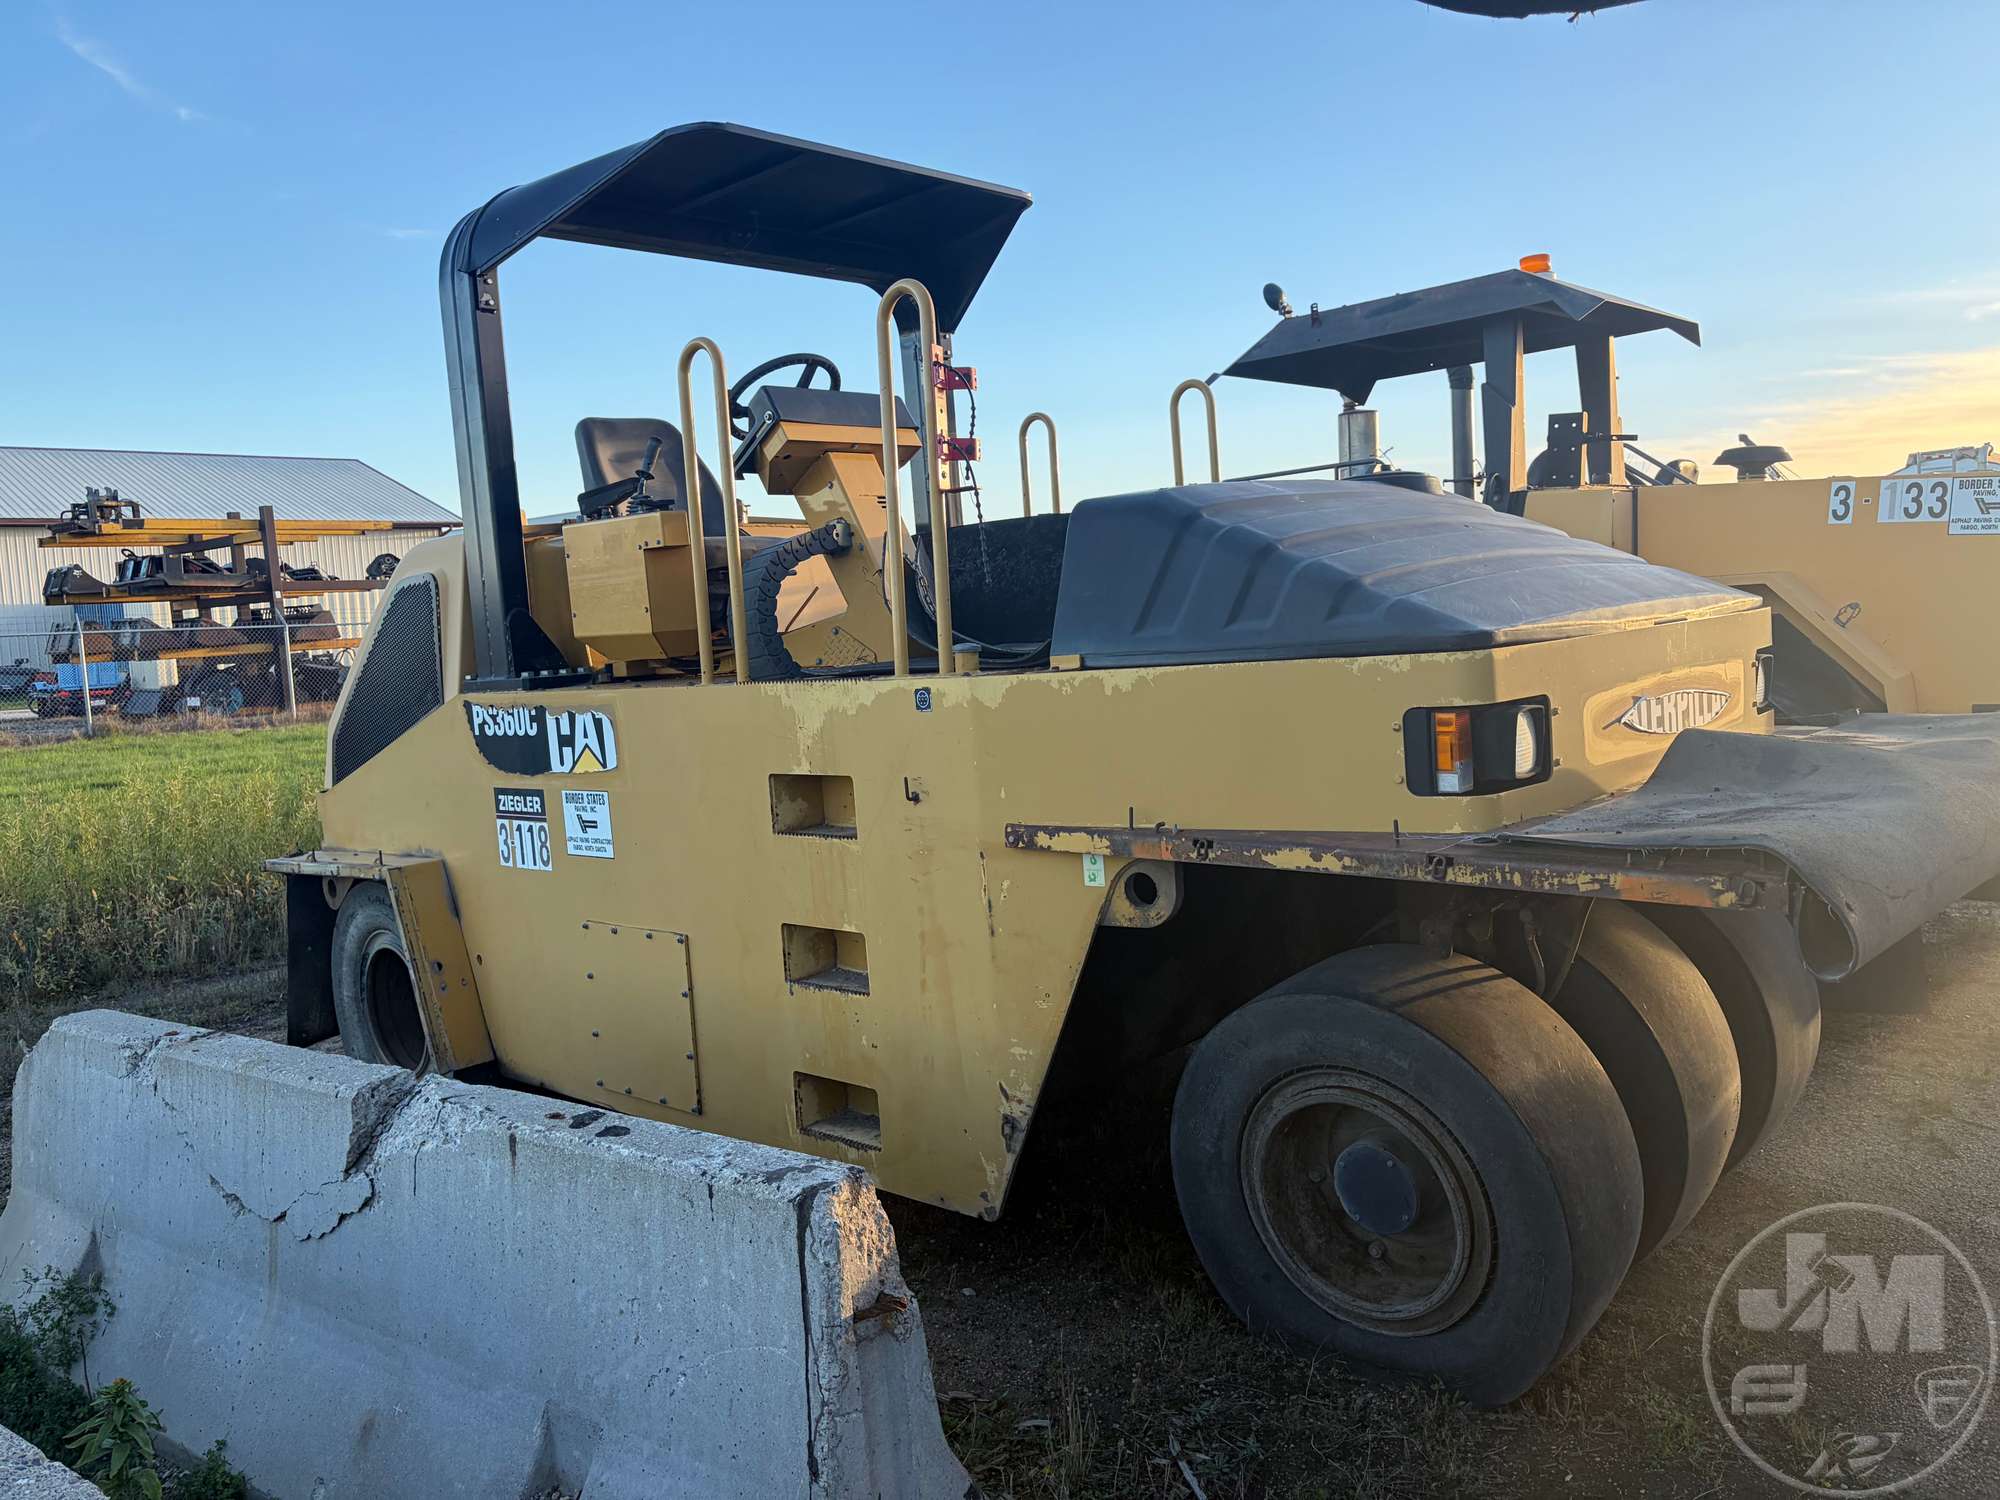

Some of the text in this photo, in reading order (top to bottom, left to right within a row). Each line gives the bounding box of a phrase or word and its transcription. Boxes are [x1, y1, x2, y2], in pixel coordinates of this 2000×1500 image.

[1959, 479, 1993, 490] BORDER
[472, 704, 537, 736] PS360C
[498, 795, 542, 813] ZIEGLER
[586, 793, 606, 806] STATES
[499, 823, 551, 867] 3-118
